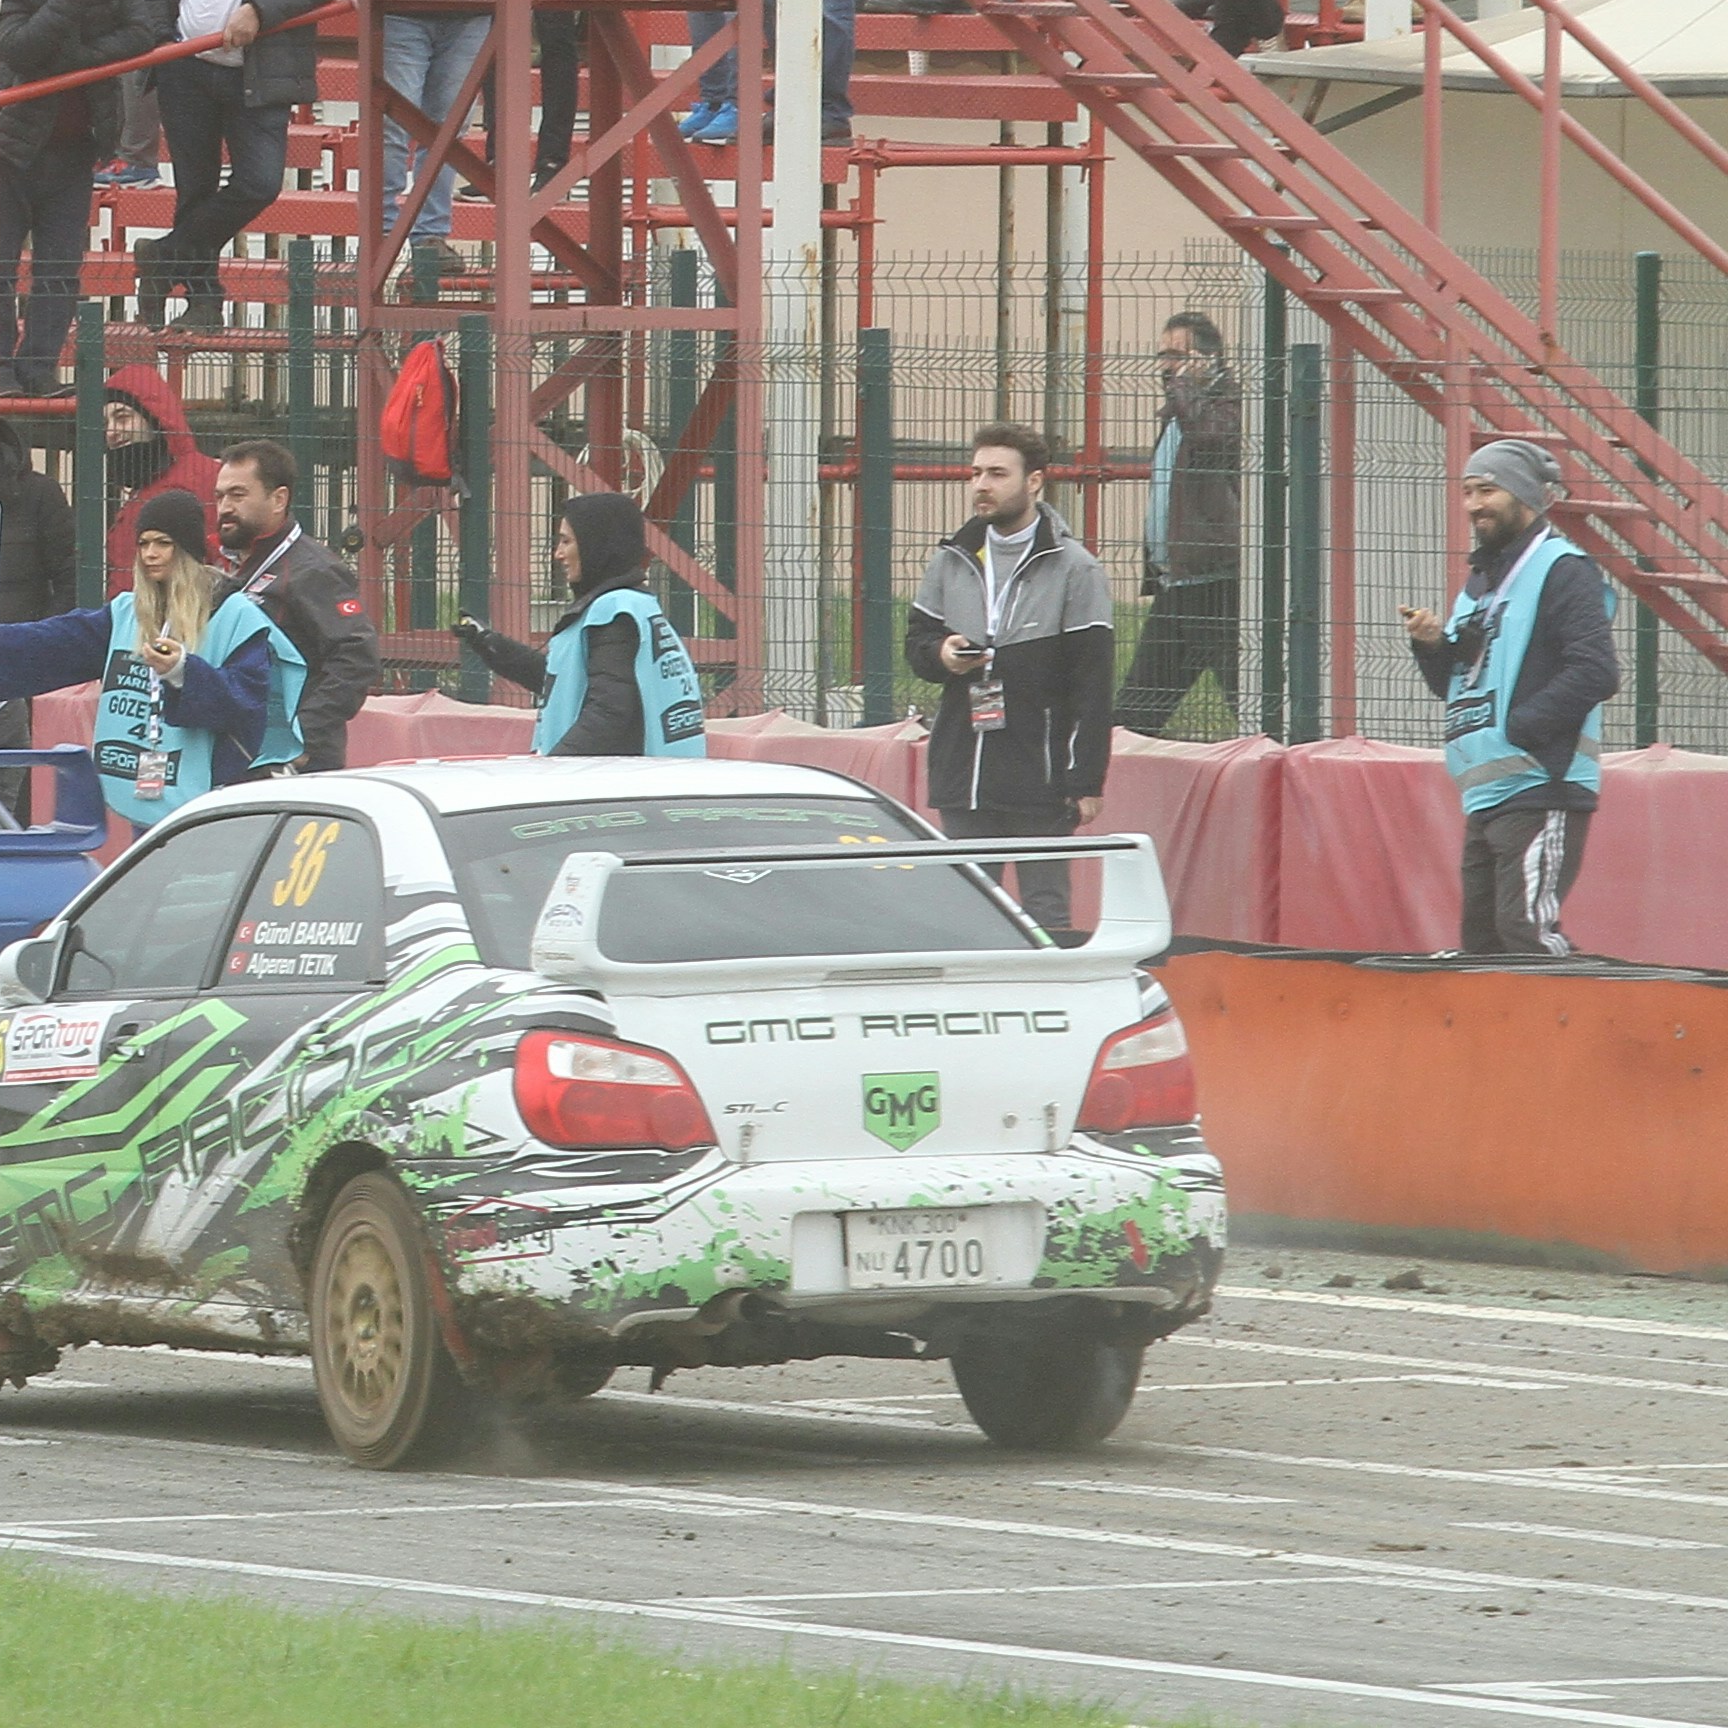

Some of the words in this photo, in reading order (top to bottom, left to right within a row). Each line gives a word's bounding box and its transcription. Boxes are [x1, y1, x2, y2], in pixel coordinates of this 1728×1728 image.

[272, 821, 341, 907] 36
[254, 921, 294, 945] Gürol
[294, 922, 363, 945] BARANLI
[246, 953, 296, 979] Alperen
[706, 1016, 835, 1044] GMG
[861, 1010, 1070, 1038] RACING
[866, 1085, 937, 1127] GMG
[894, 1238, 983, 1281] 4700
